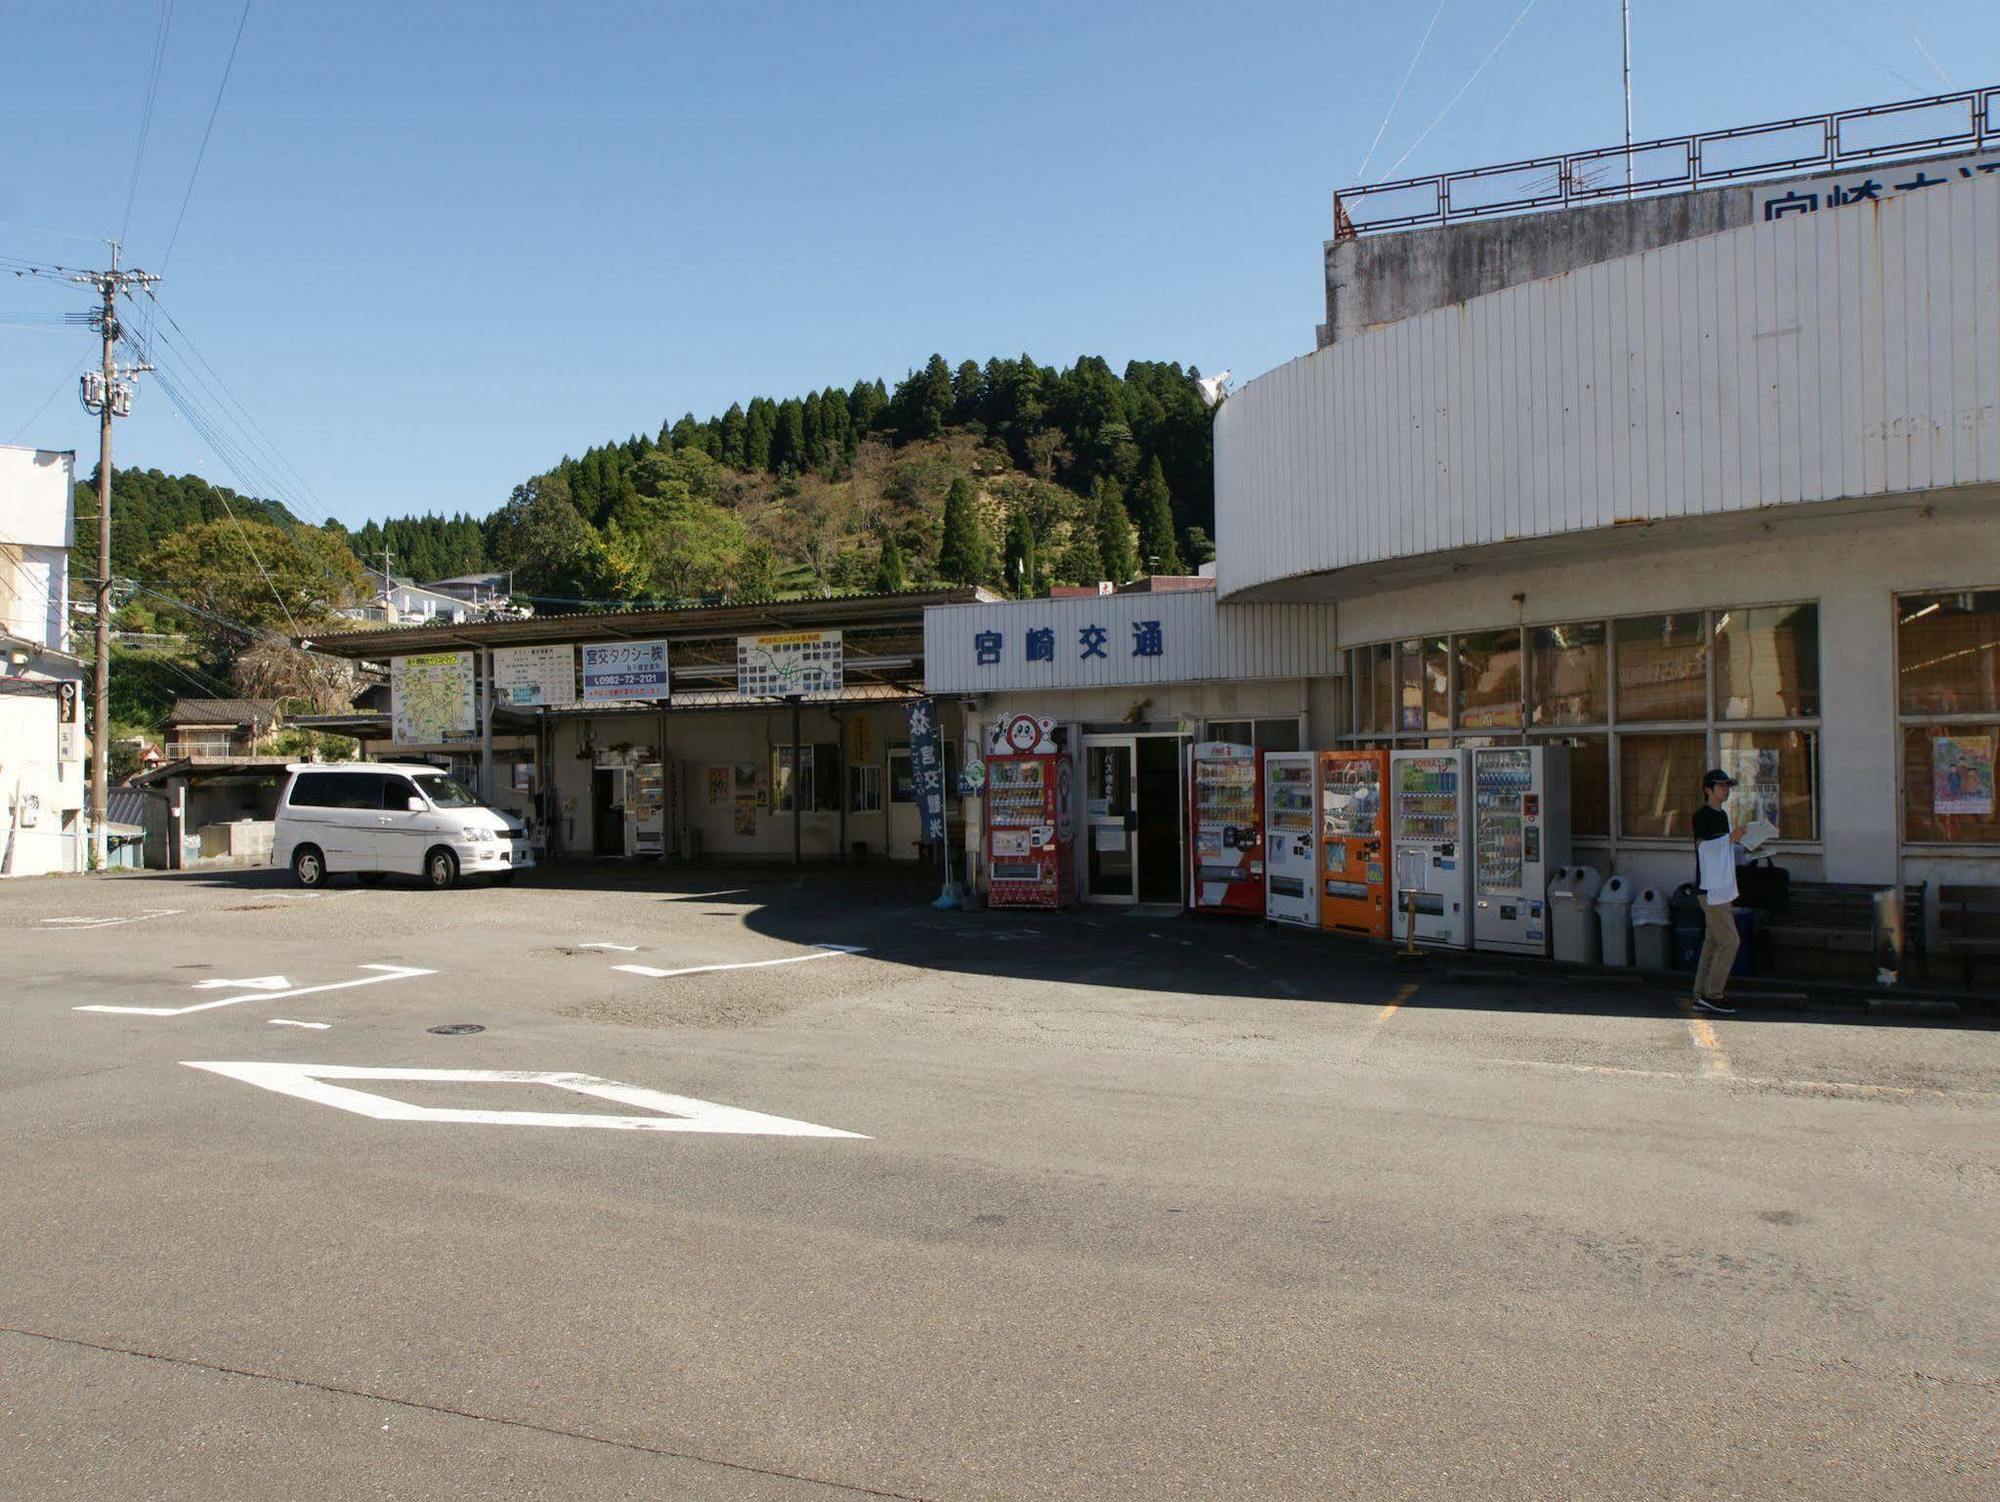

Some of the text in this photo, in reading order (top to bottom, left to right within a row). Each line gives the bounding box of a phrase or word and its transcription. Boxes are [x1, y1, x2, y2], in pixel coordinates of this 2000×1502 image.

[975, 620, 1164, 666] 宮崎交通
[600, 674, 656, 685] 0982-72-2121
